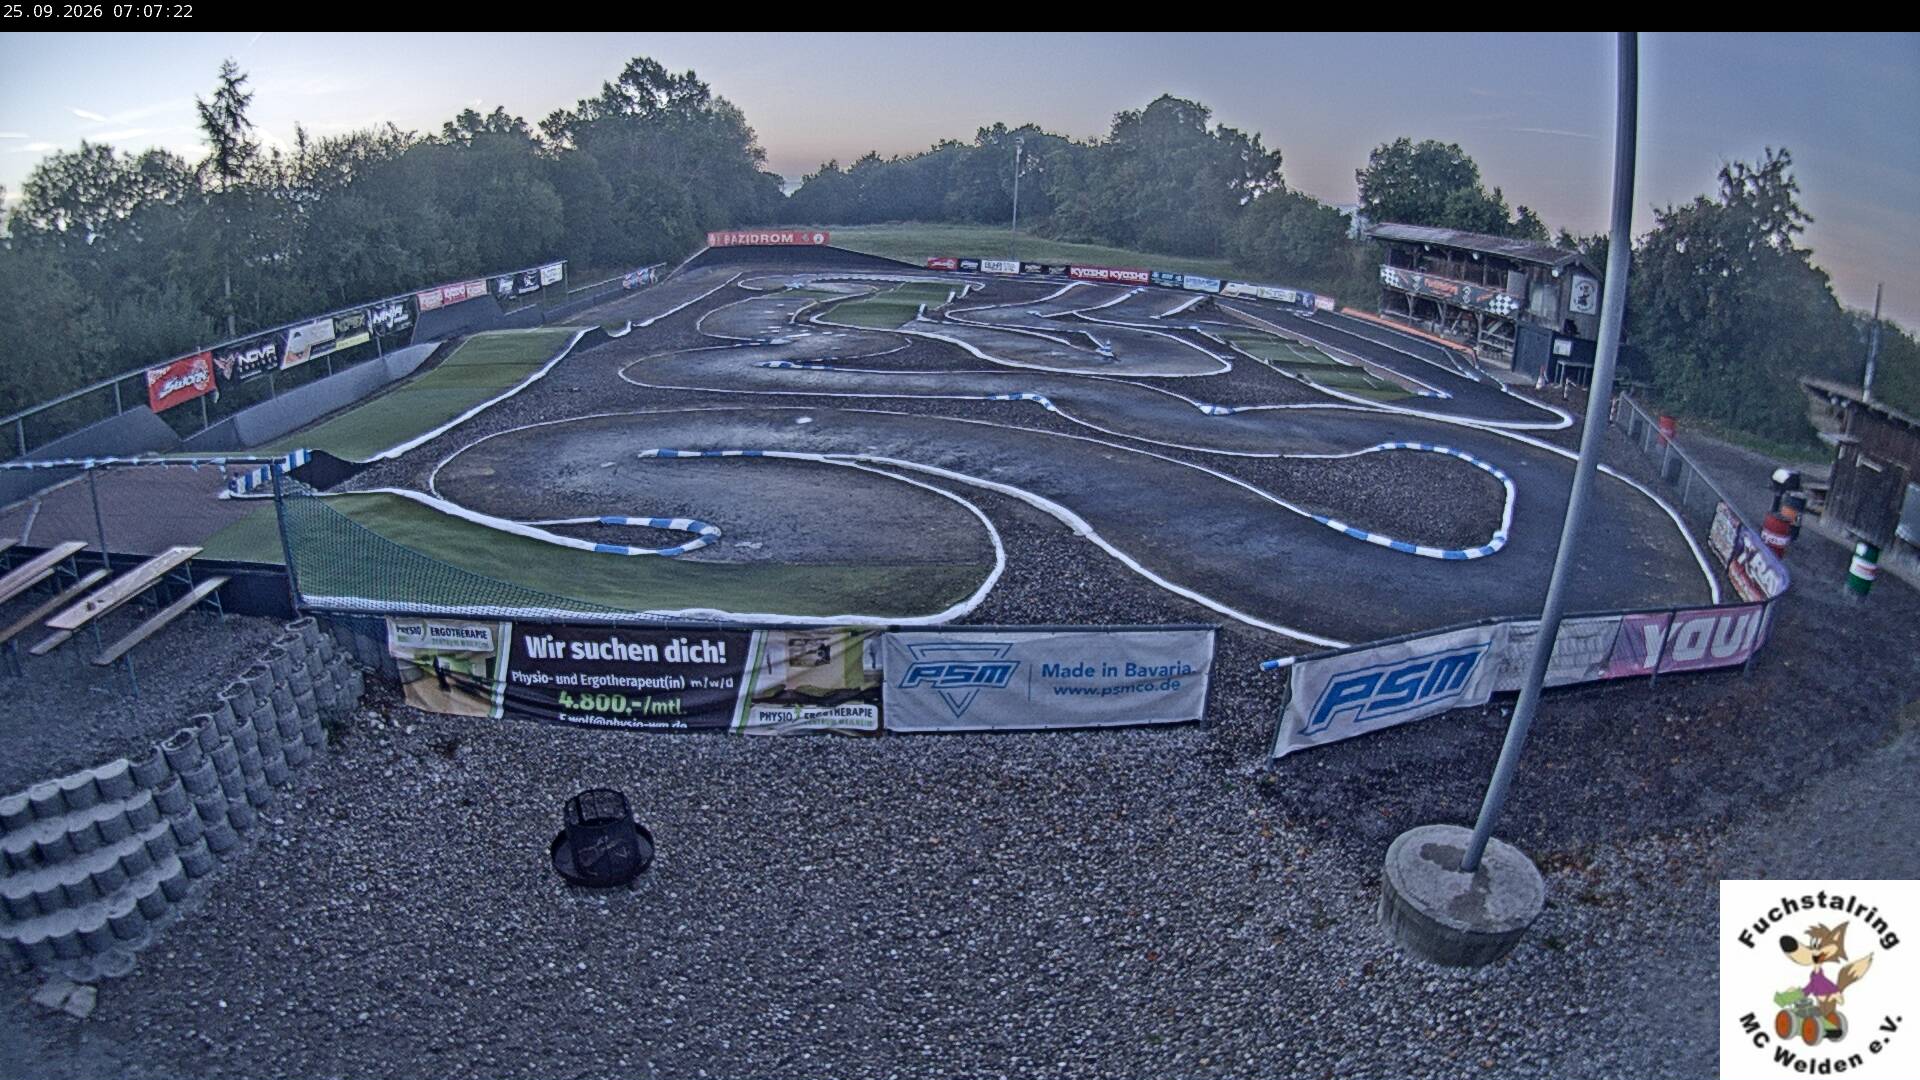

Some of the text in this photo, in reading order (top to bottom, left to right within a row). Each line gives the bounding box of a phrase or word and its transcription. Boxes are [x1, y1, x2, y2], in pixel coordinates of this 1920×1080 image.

[525, 634, 727, 664] Wir suchen dich!
[1042, 662, 1095, 678] Made
[1102, 662, 1118, 677] in
[511, 670, 554, 686] Physio-
[555, 672, 579, 685] und
[580, 674, 686, 690] Ergotherapeut(in)
[1053, 678, 1181, 697] www.psmco.de
[1310, 650, 1483, 727] PSM
[759, 711, 793, 722] PHYSIO
